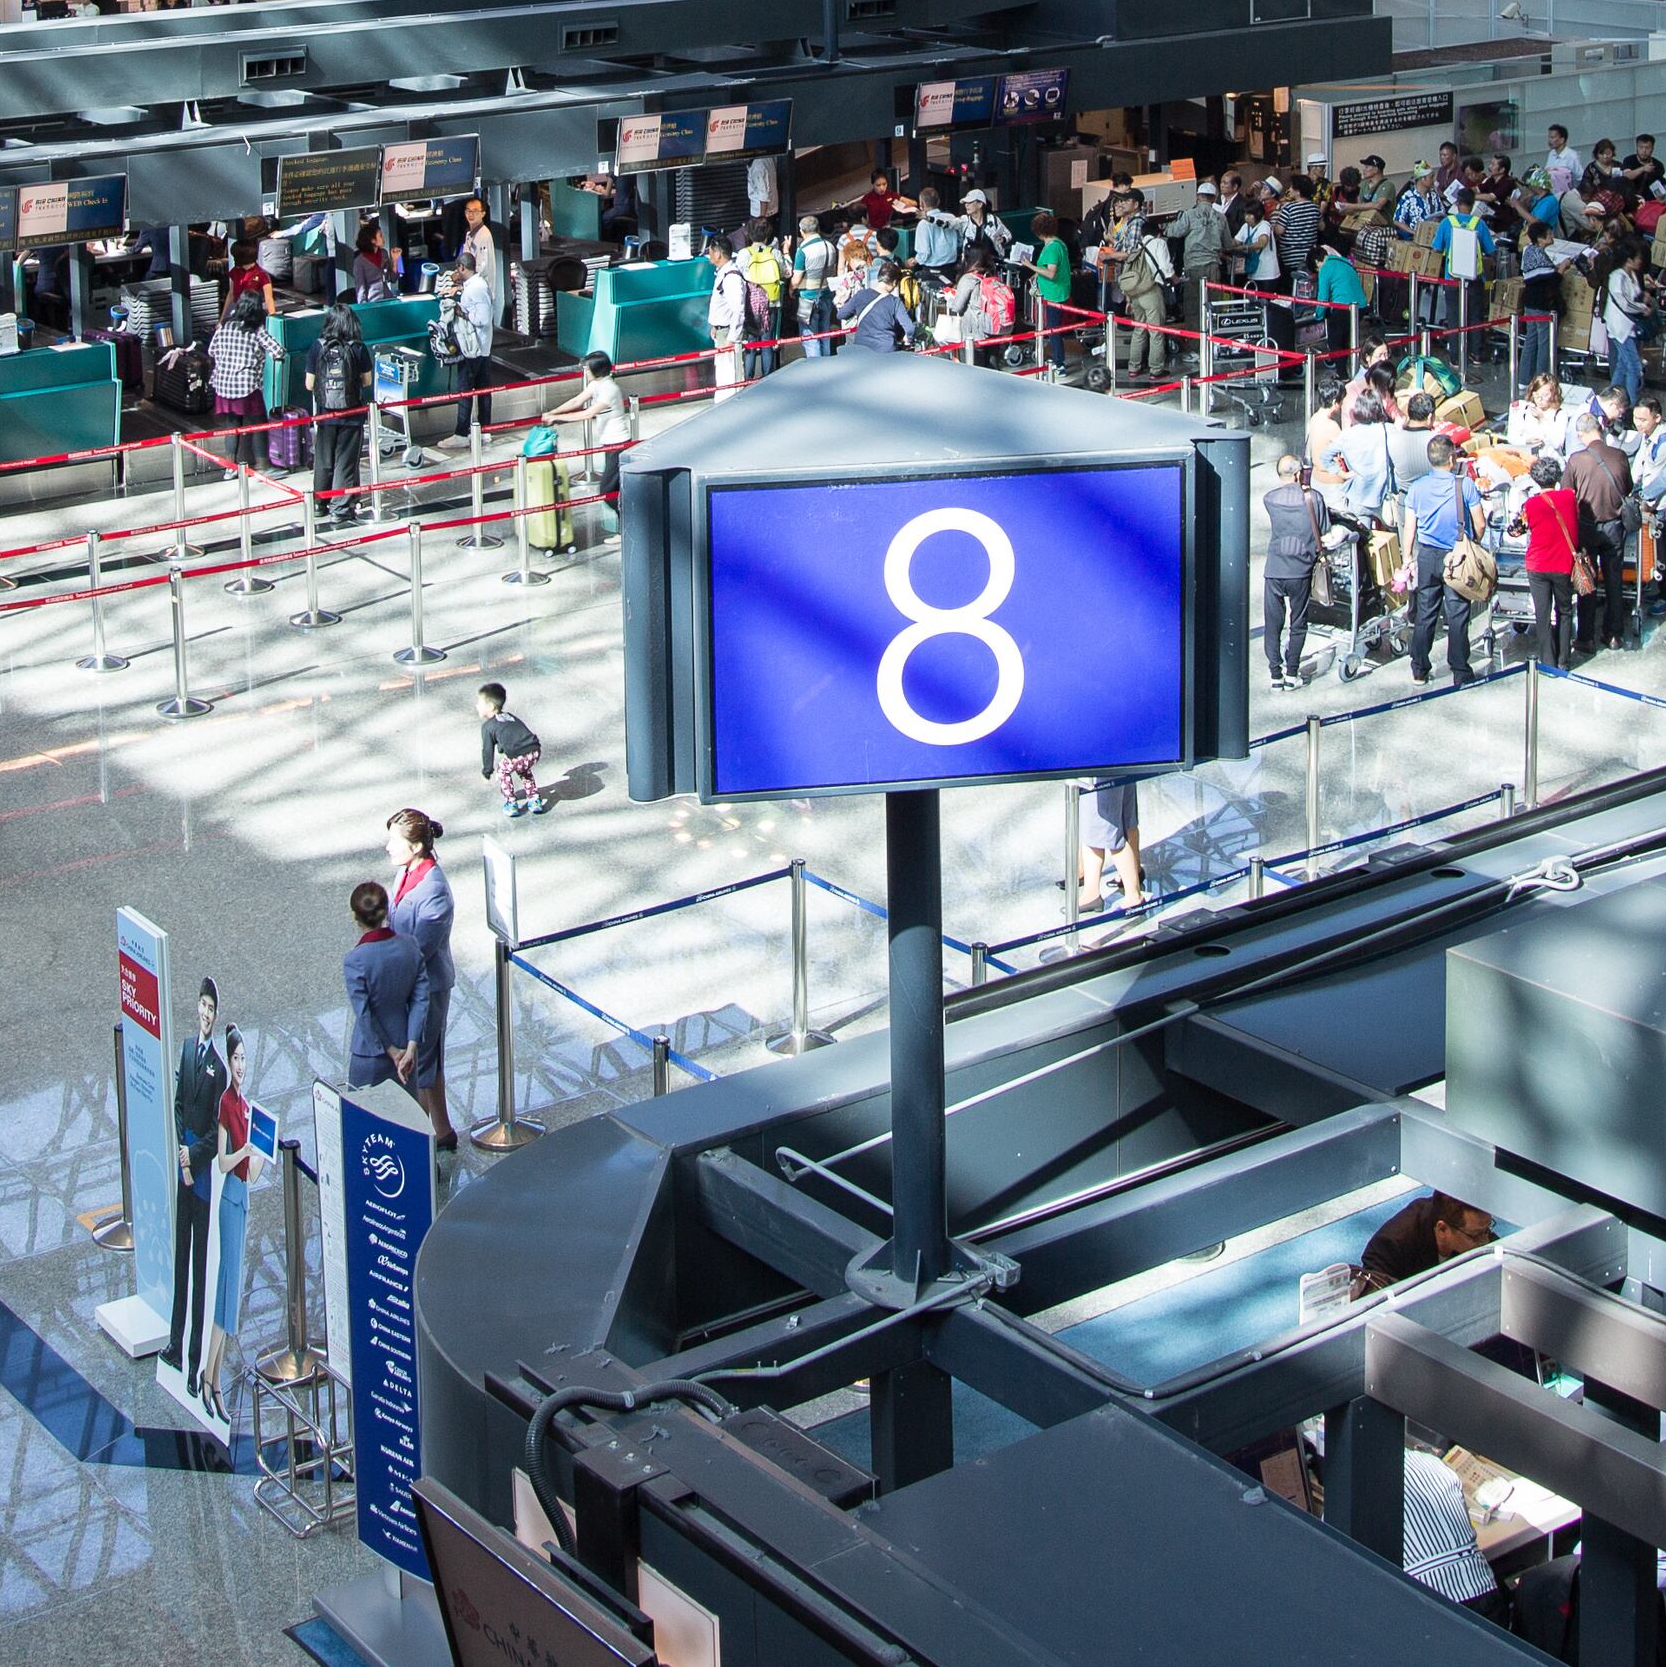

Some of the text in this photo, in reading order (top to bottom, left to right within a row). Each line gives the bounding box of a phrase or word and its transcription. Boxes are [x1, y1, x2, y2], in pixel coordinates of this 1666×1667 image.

[407, 154, 425, 162] CHINA
[46, 196, 67, 204] CHINA
[1230, 317, 1259, 325] LEXUS
[876, 505, 1026, 746] 8
[121, 978, 136, 998] SKY
[122, 990, 157, 1026] PRIORITY
[361, 1133, 395, 1176] SKYTEAM
[390, 1381, 412, 1398] DELTA
